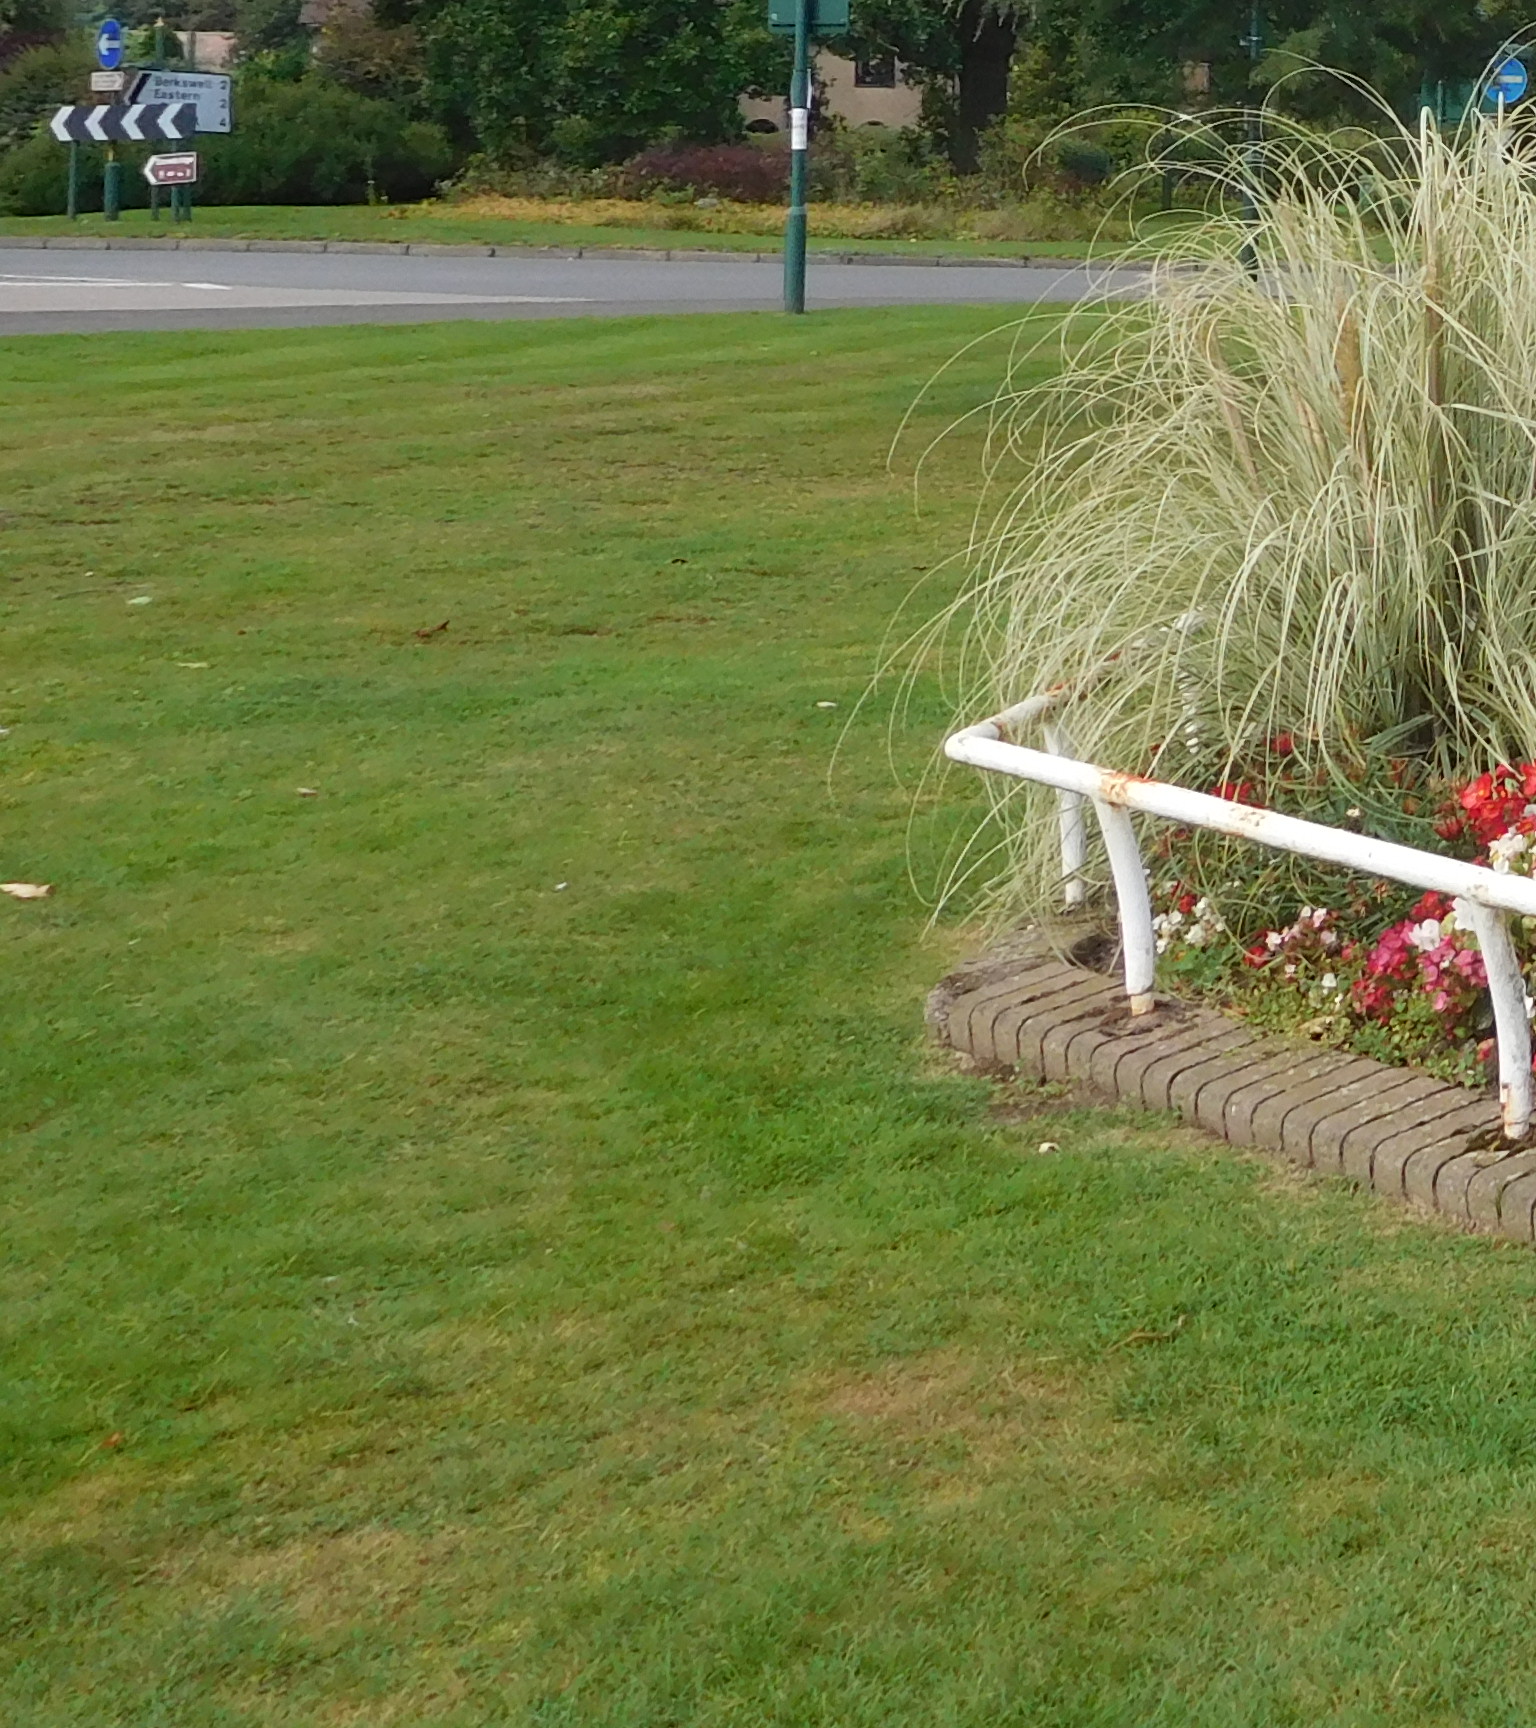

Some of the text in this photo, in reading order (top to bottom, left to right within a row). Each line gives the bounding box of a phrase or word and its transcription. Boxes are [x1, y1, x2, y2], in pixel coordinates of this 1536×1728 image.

[154, 76, 228, 90] Berkswell 2
[153, 89, 200, 100] Eastern
[219, 99, 228, 109] 2
[219, 117, 227, 127] 4
